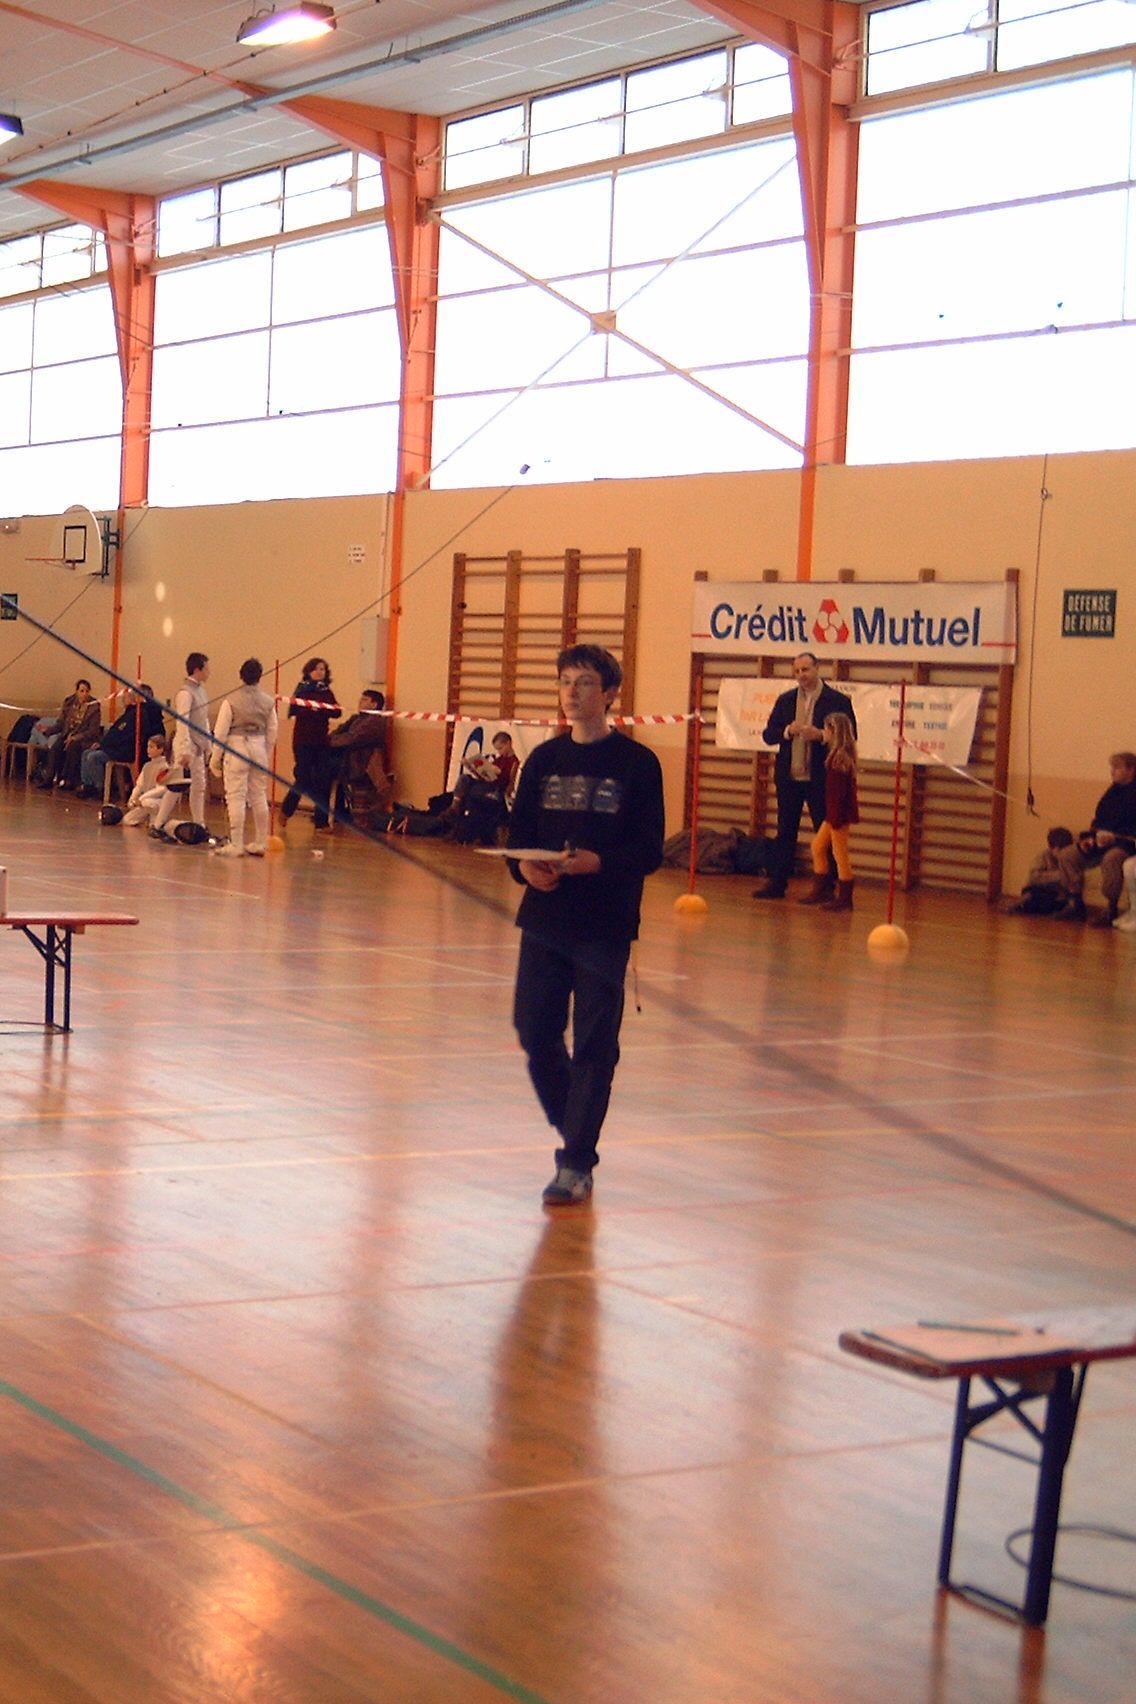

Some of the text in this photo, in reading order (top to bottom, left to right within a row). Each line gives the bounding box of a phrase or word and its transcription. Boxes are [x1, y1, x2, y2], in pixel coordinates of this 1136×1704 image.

[710, 602, 981, 646] Crédit Mutuel
[1064, 614, 1113, 632] DE FUMER
